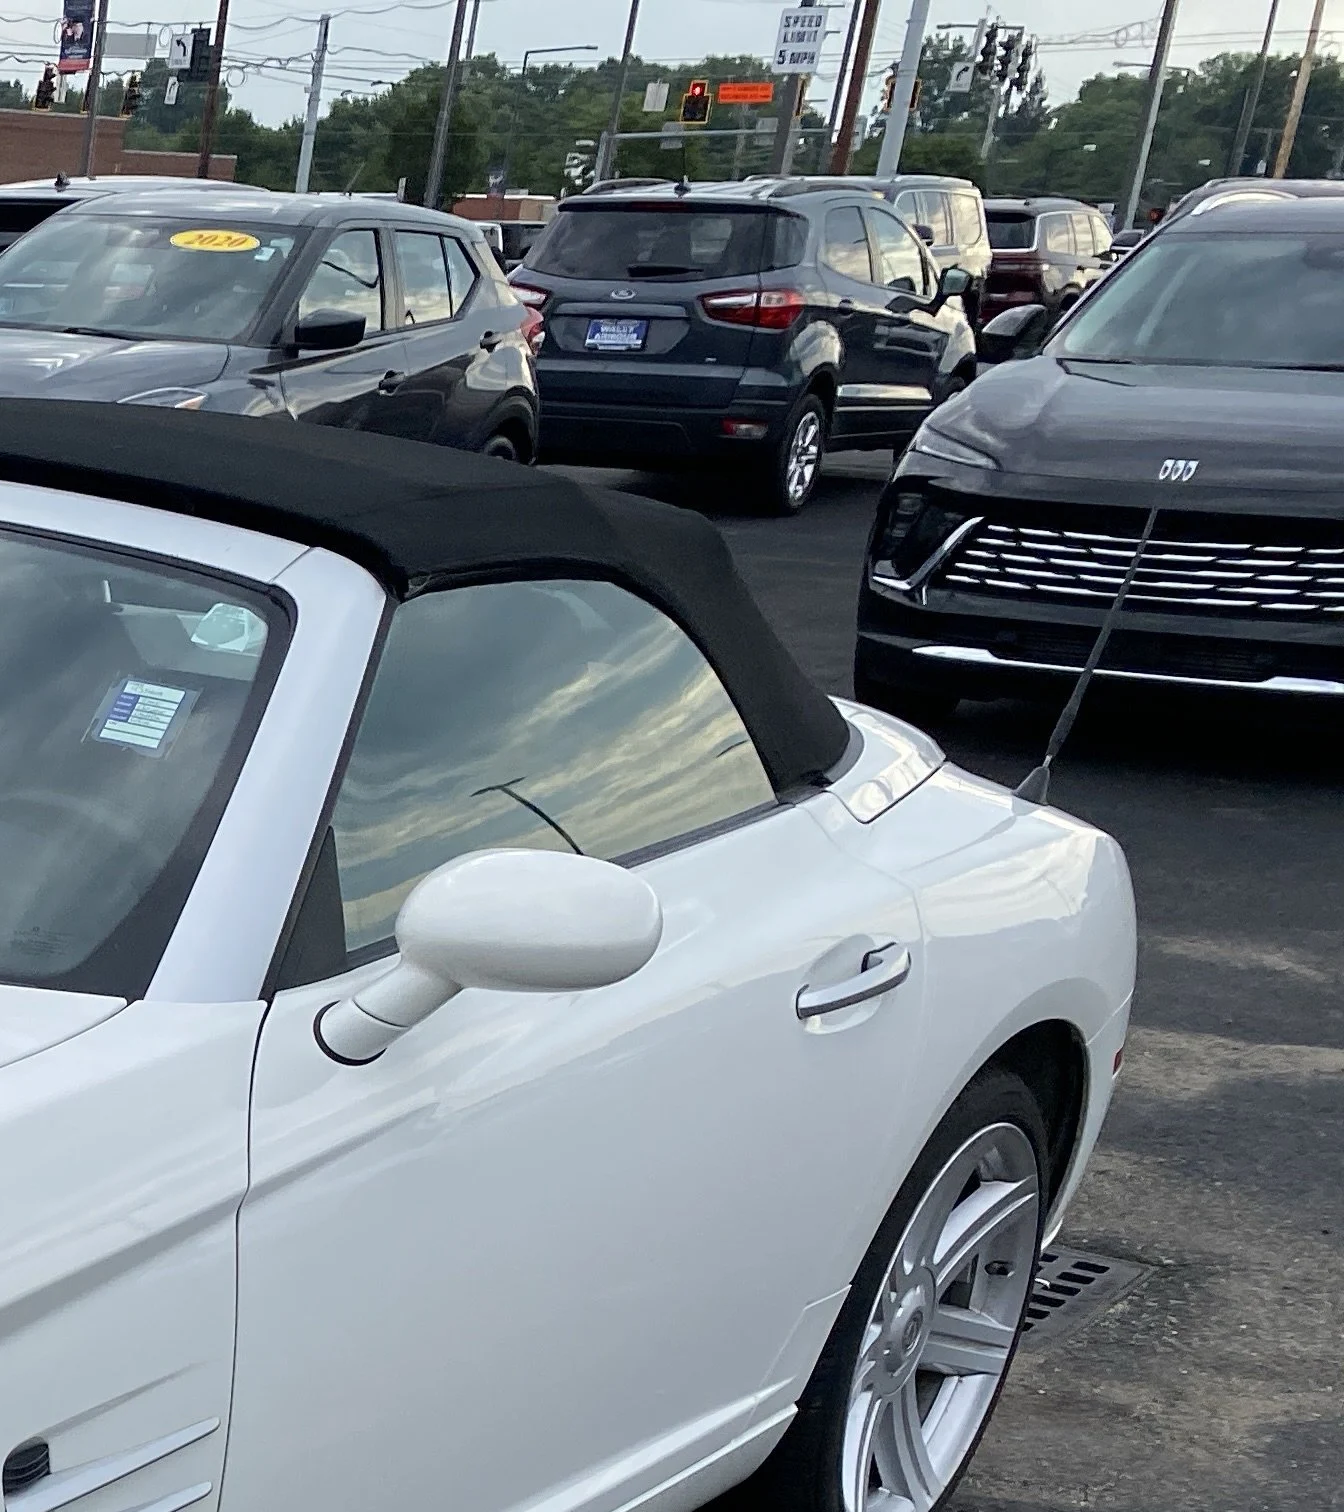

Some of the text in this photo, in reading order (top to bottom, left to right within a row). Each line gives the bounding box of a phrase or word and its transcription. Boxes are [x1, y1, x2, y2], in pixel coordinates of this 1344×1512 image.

[784, 15, 823, 28] SPEED
[783, 30, 818, 43] LIMIT
[777, 50, 816, 65] 5 MPH
[184, 234, 248, 248] 2020
